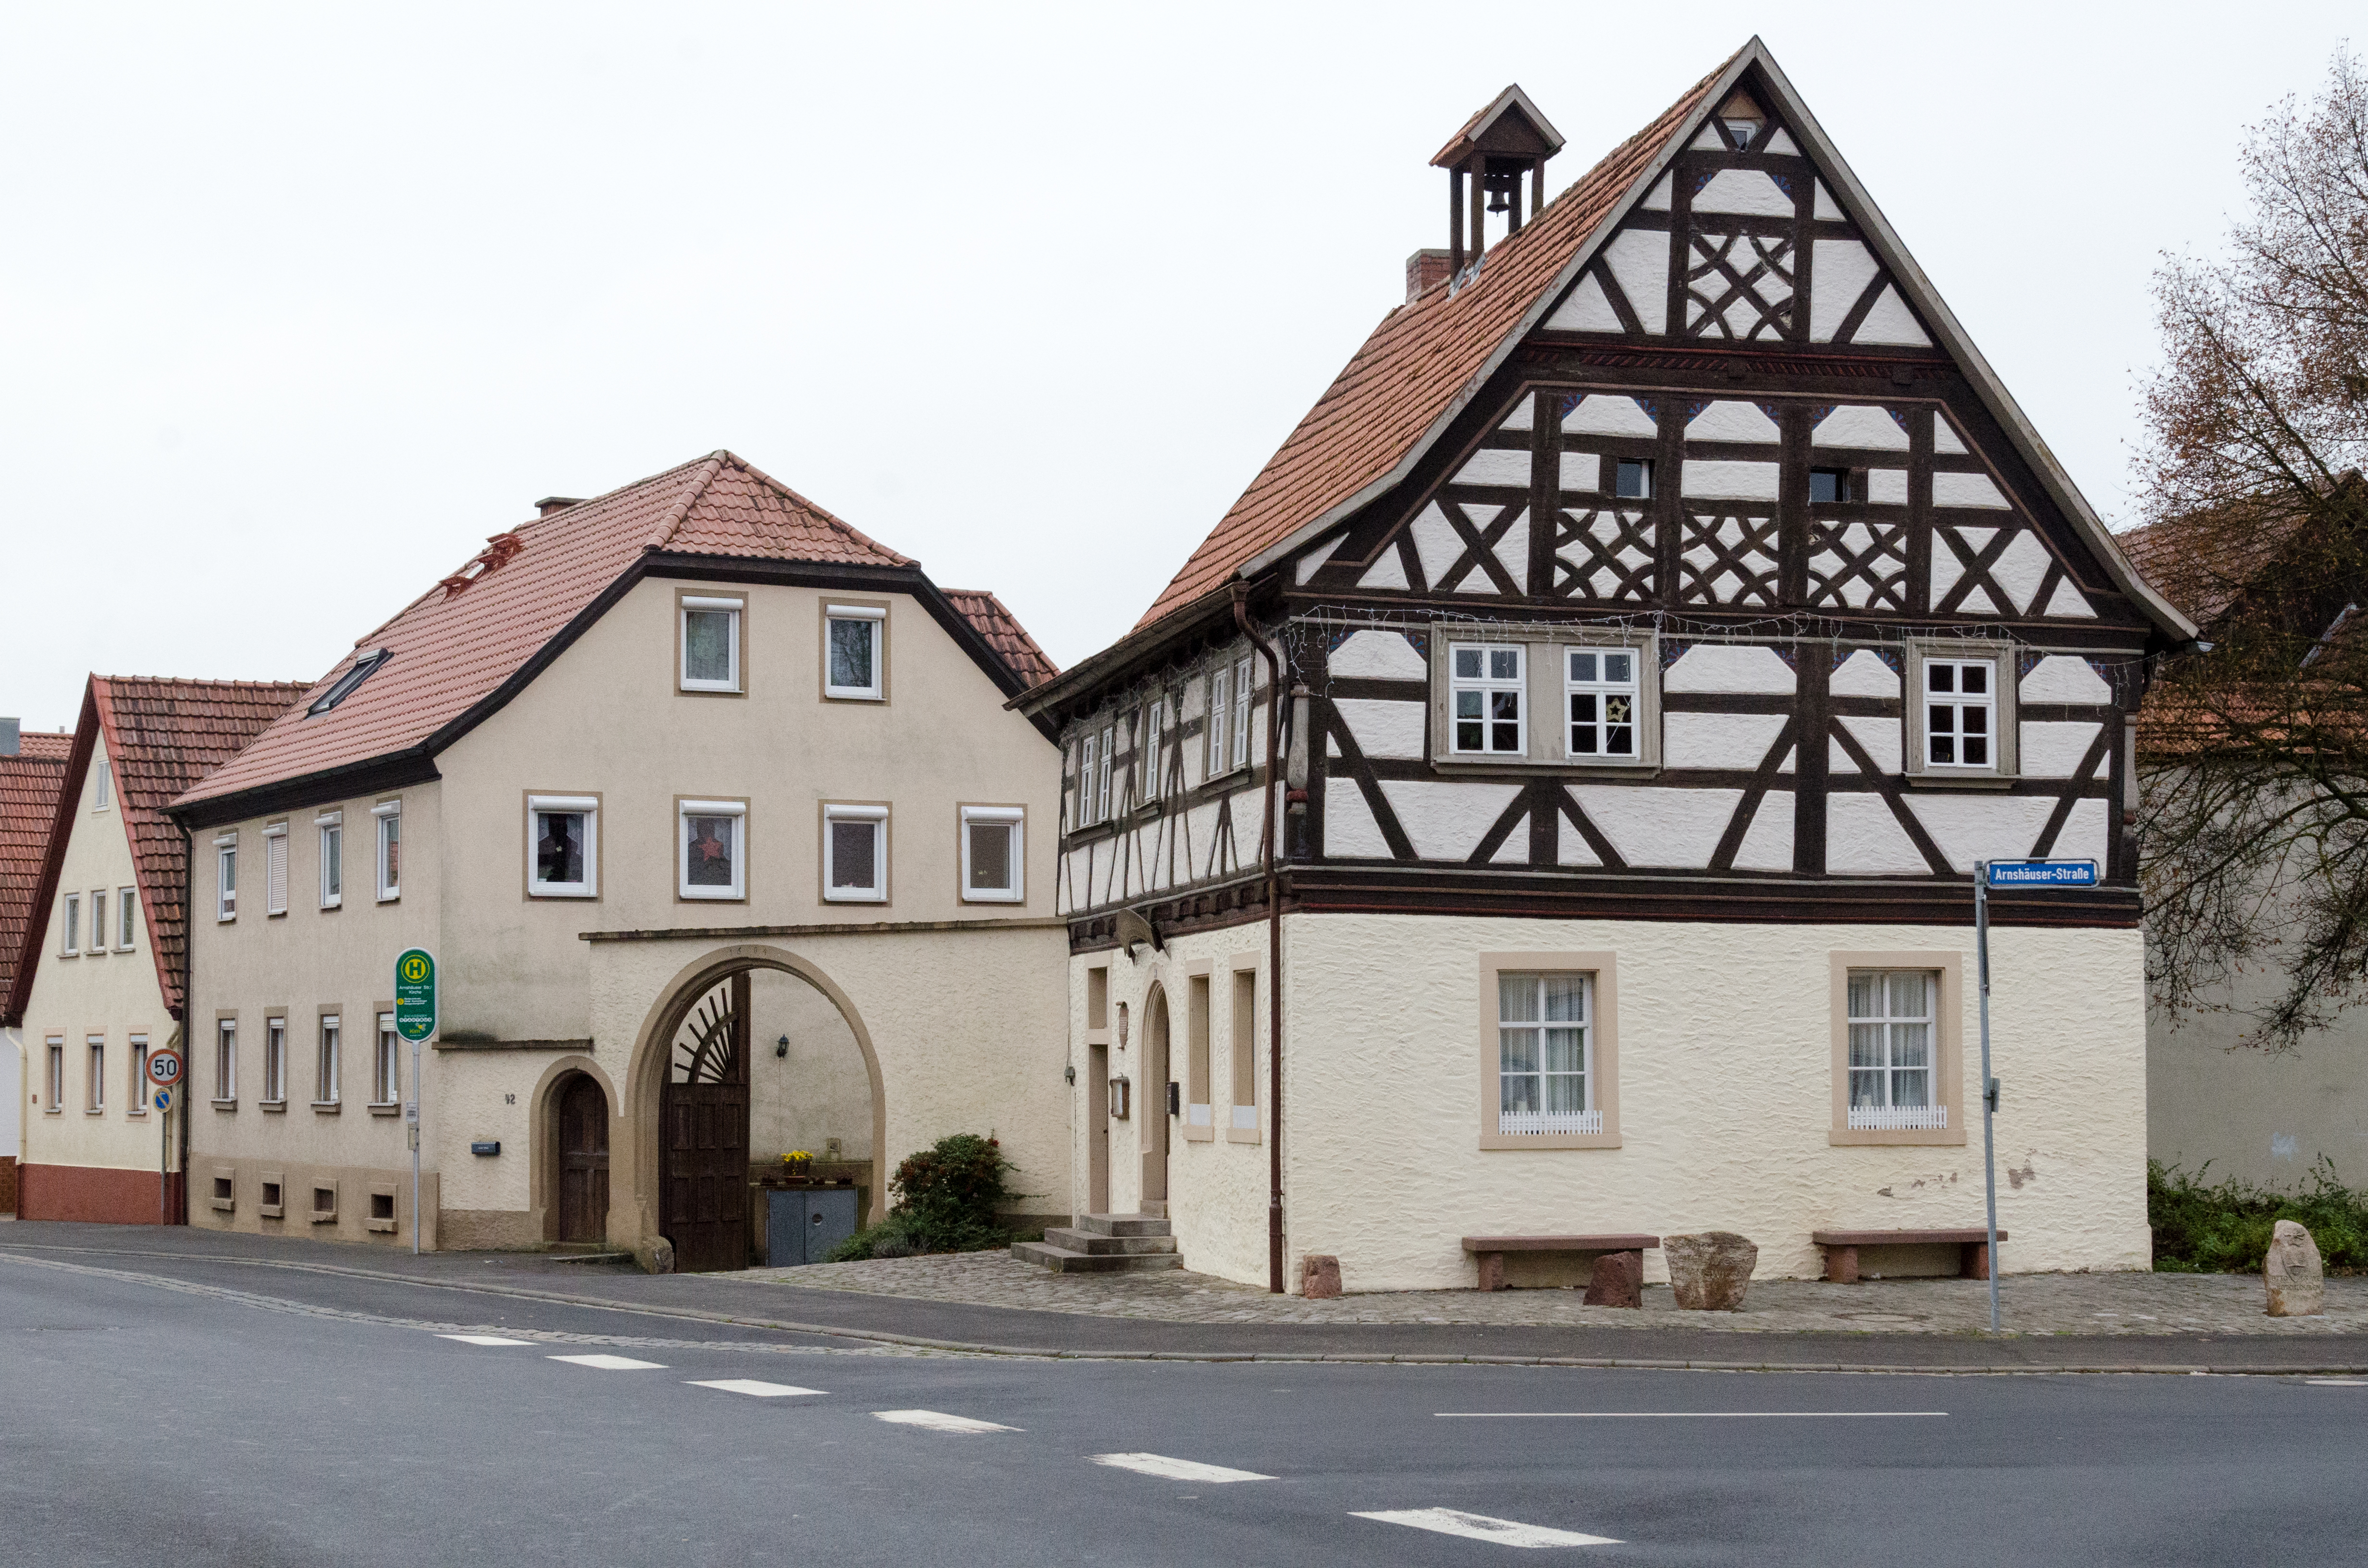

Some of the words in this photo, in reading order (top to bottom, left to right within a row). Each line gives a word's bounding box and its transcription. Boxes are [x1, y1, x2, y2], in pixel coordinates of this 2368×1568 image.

[1995, 868, 2089, 880] Arnshäuser-Straße
[409, 962, 422, 976] H
[155, 1059, 177, 1076] 50
